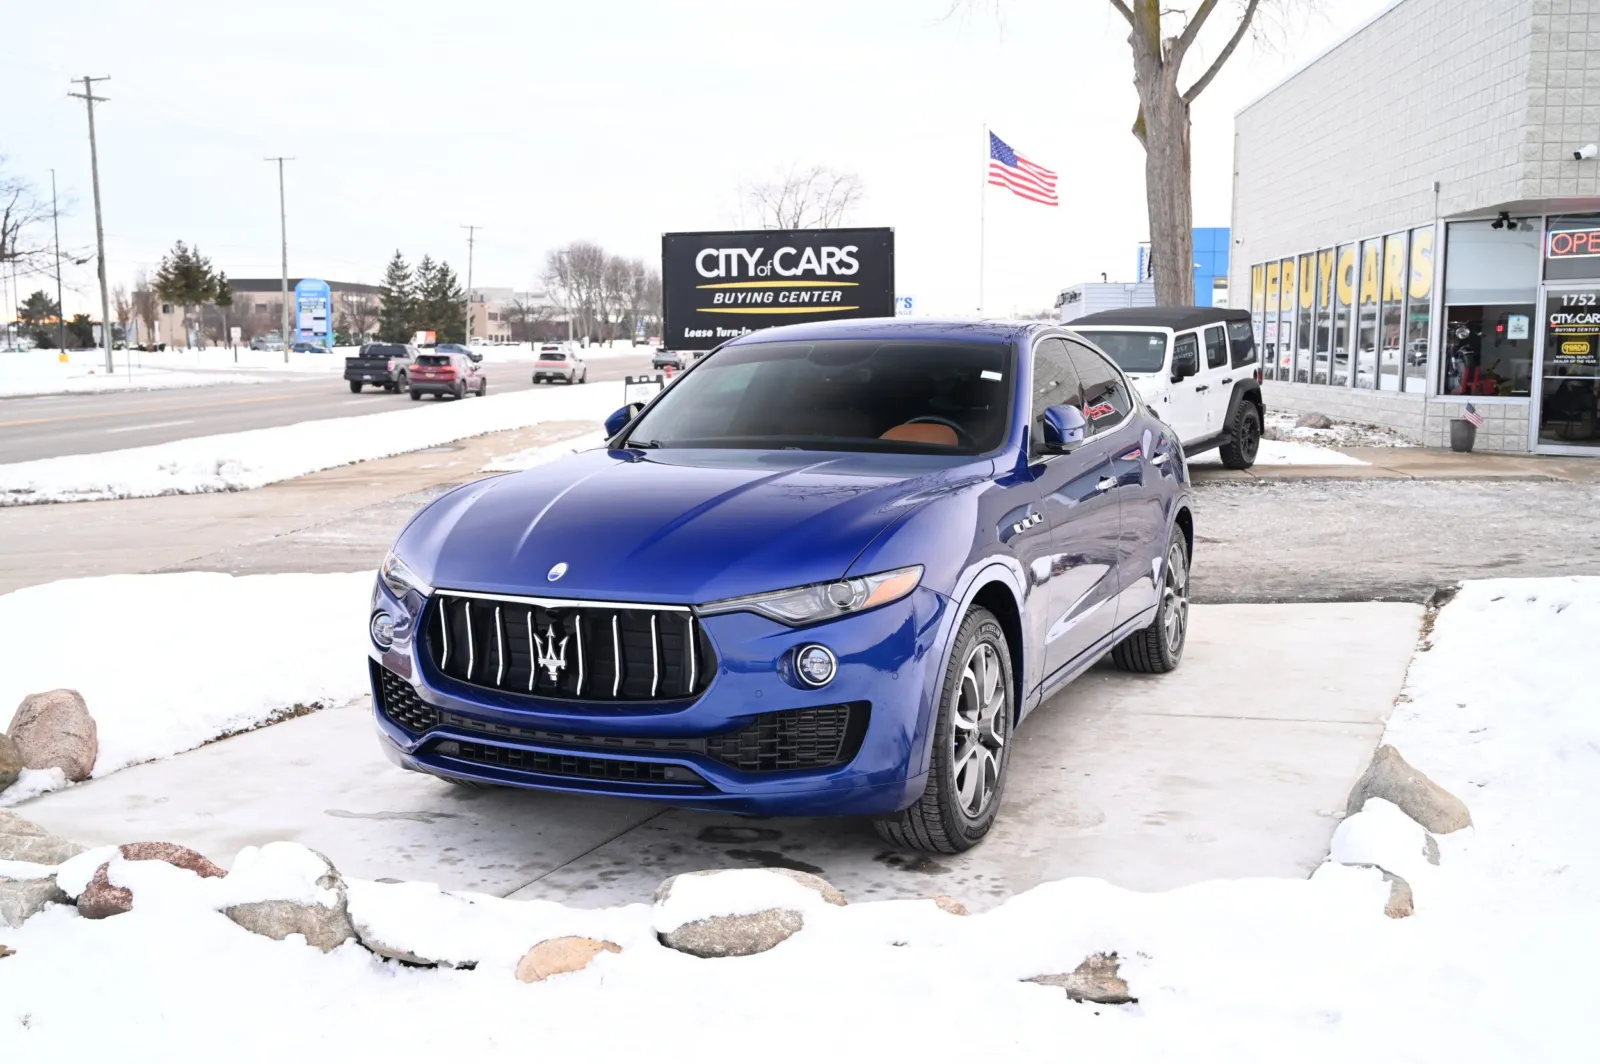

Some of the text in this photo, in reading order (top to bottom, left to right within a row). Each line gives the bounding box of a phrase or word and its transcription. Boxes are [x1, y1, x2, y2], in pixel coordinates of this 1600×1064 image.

[695, 245, 860, 278] CITY of CARS
[713, 290, 843, 304] BUYING CENTER
[1561, 293, 1597, 306] 1752
[1550, 313, 1574, 324] CITY
[684, 327, 713, 338] Lease
